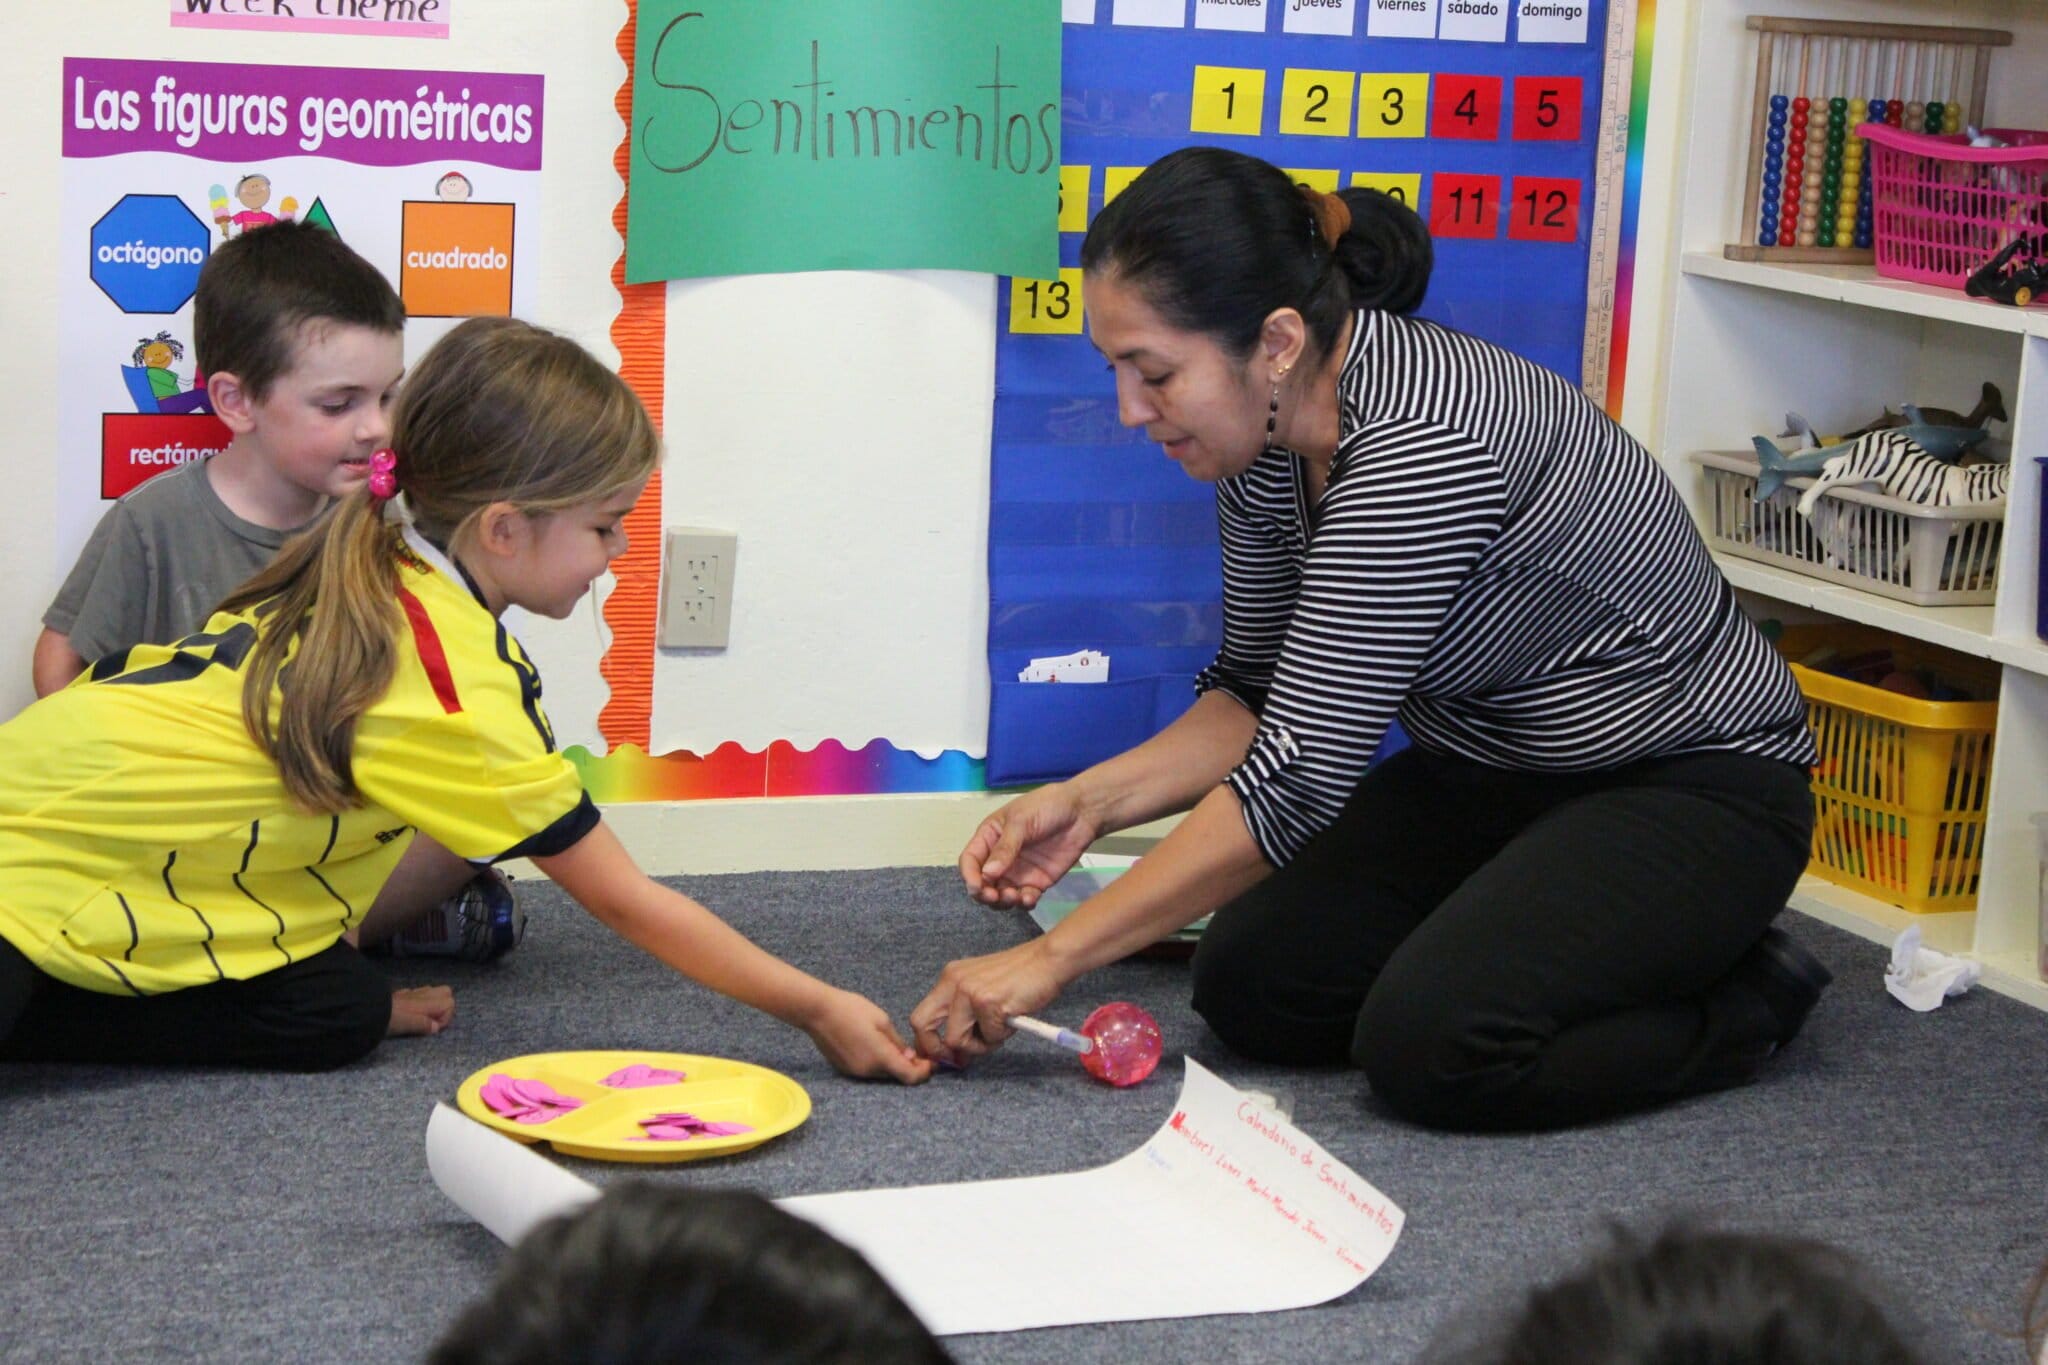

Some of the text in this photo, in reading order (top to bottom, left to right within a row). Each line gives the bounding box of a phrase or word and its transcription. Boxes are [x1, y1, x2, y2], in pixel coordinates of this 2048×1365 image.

[1377, 0, 1426, 11] viernes
[1521, 2, 1583, 21] domingo
[641, 12, 1056, 174] Sentimientos
[1222, 82, 1560, 129] 1 2 3 4 5
[74, 75, 533, 152] Las figuras geométricas
[1448, 186, 1568, 228] 11 12
[97, 240, 205, 270] octágono
[406, 246, 508, 270] cuadrado
[1024, 281, 1070, 320] 13
